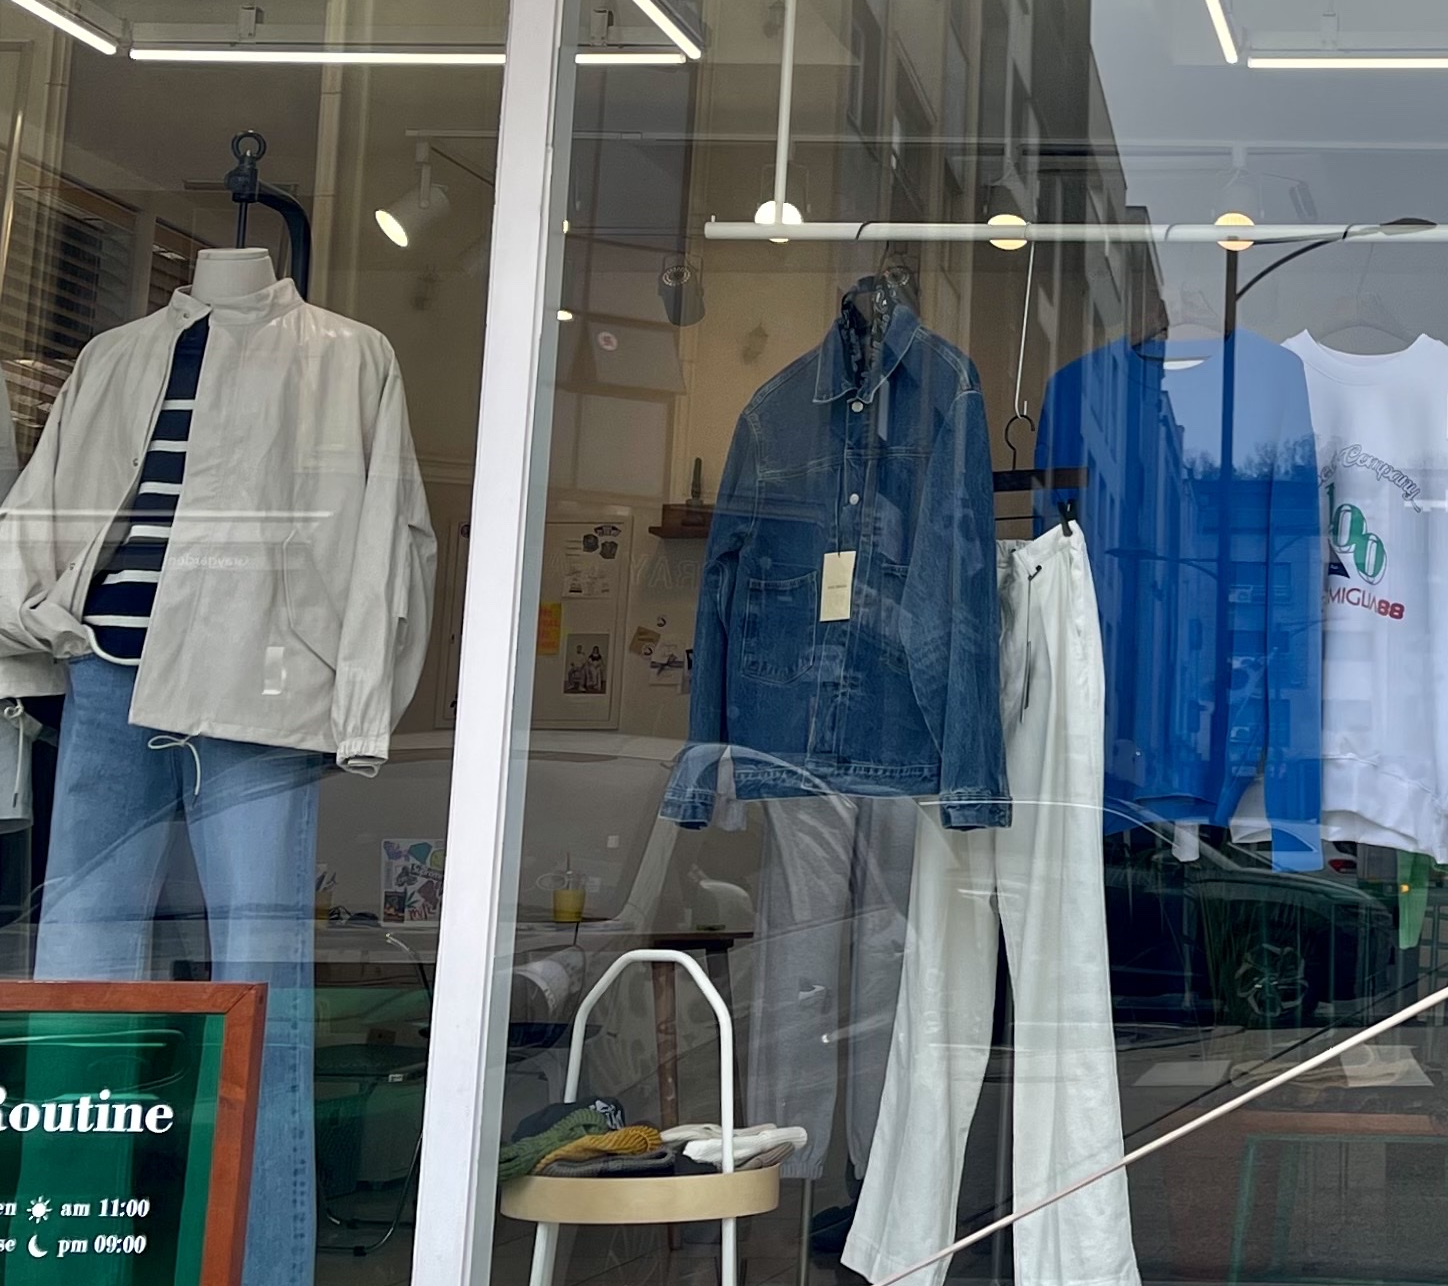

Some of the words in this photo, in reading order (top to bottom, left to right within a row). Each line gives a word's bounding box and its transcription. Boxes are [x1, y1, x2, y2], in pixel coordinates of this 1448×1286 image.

[0, 1085, 174, 1134] outine
[0, 1201, 18, 1217] en
[60, 1202, 91, 1217] am
[98, 1198, 150, 1218] 11:00
[57, 1238, 88, 1258] pm
[94, 1234, 147, 1254] 09:00
